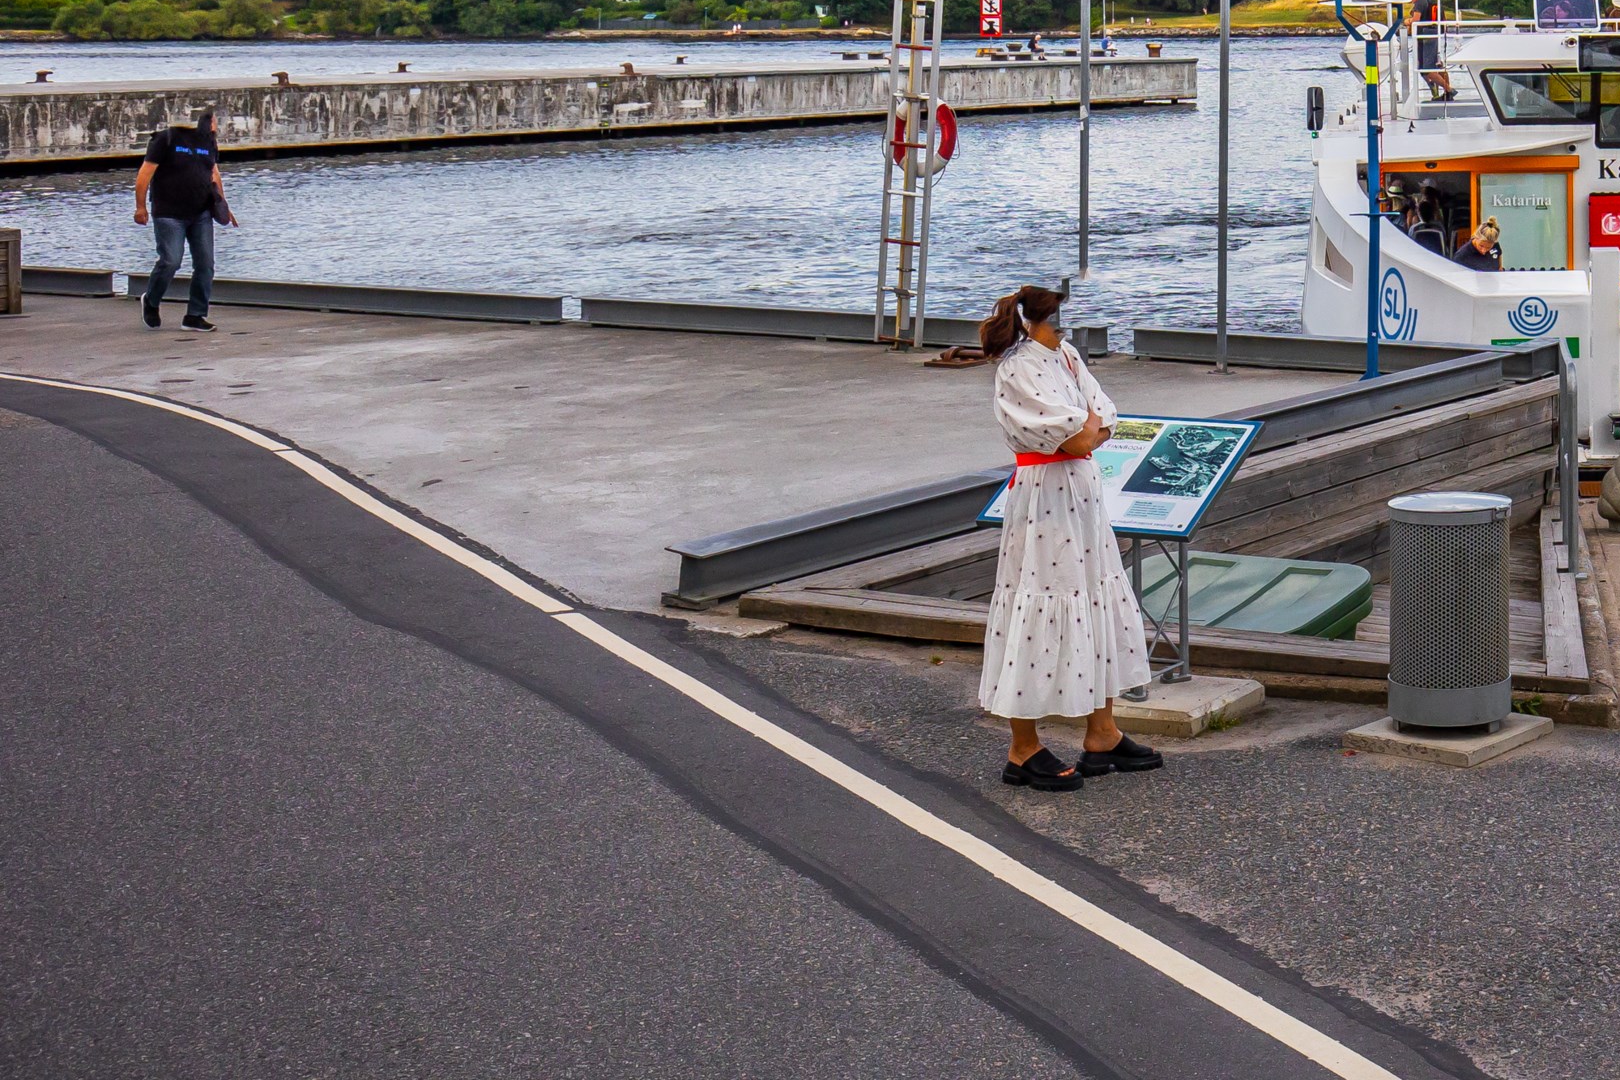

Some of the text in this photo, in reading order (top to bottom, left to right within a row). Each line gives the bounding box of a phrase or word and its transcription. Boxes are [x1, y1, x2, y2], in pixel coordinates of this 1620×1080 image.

[1492, 194, 1552, 207] Katarina
[1384, 287, 1400, 320] SL
[1525, 304, 1542, 318] SL
